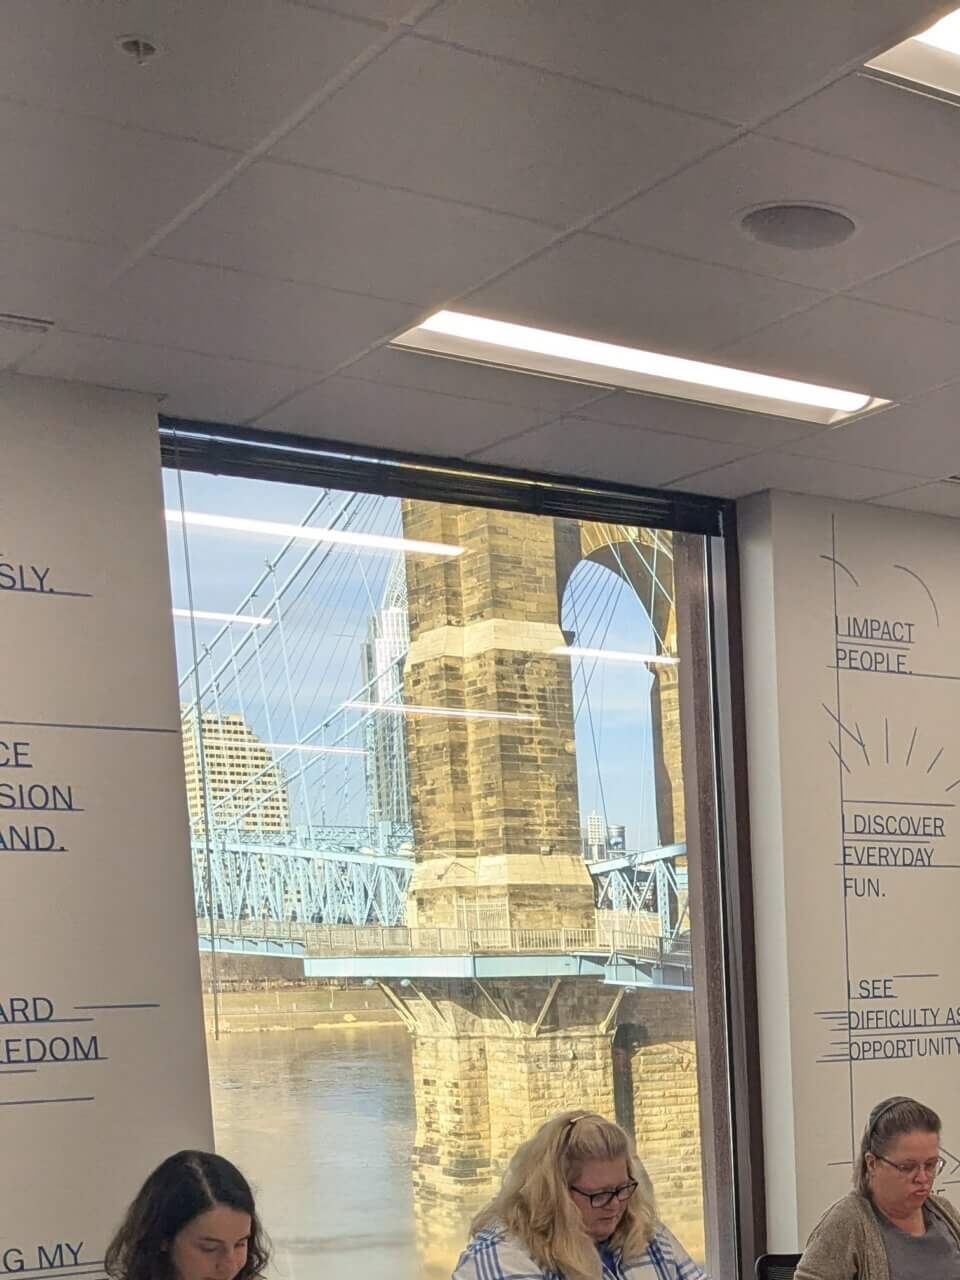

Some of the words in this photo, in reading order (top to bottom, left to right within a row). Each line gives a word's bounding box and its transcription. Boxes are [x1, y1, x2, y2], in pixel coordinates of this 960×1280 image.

[0, 563, 54, 592] SLY.
[847, 616, 915, 643] IMPACT
[836, 648, 912, 675] PEOPLE.
[0, 783, 73, 809] SION
[854, 814, 945, 836] DISCOVER
[843, 846, 935, 867] EVERYDAY
[844, 877, 886, 897] FUN.
[859, 979, 893, 999] SEE
[848, 1007, 940, 1030] DIFFICULTY
[3, 1248, 25, 1272] G
[37, 1241, 83, 1269] MY
